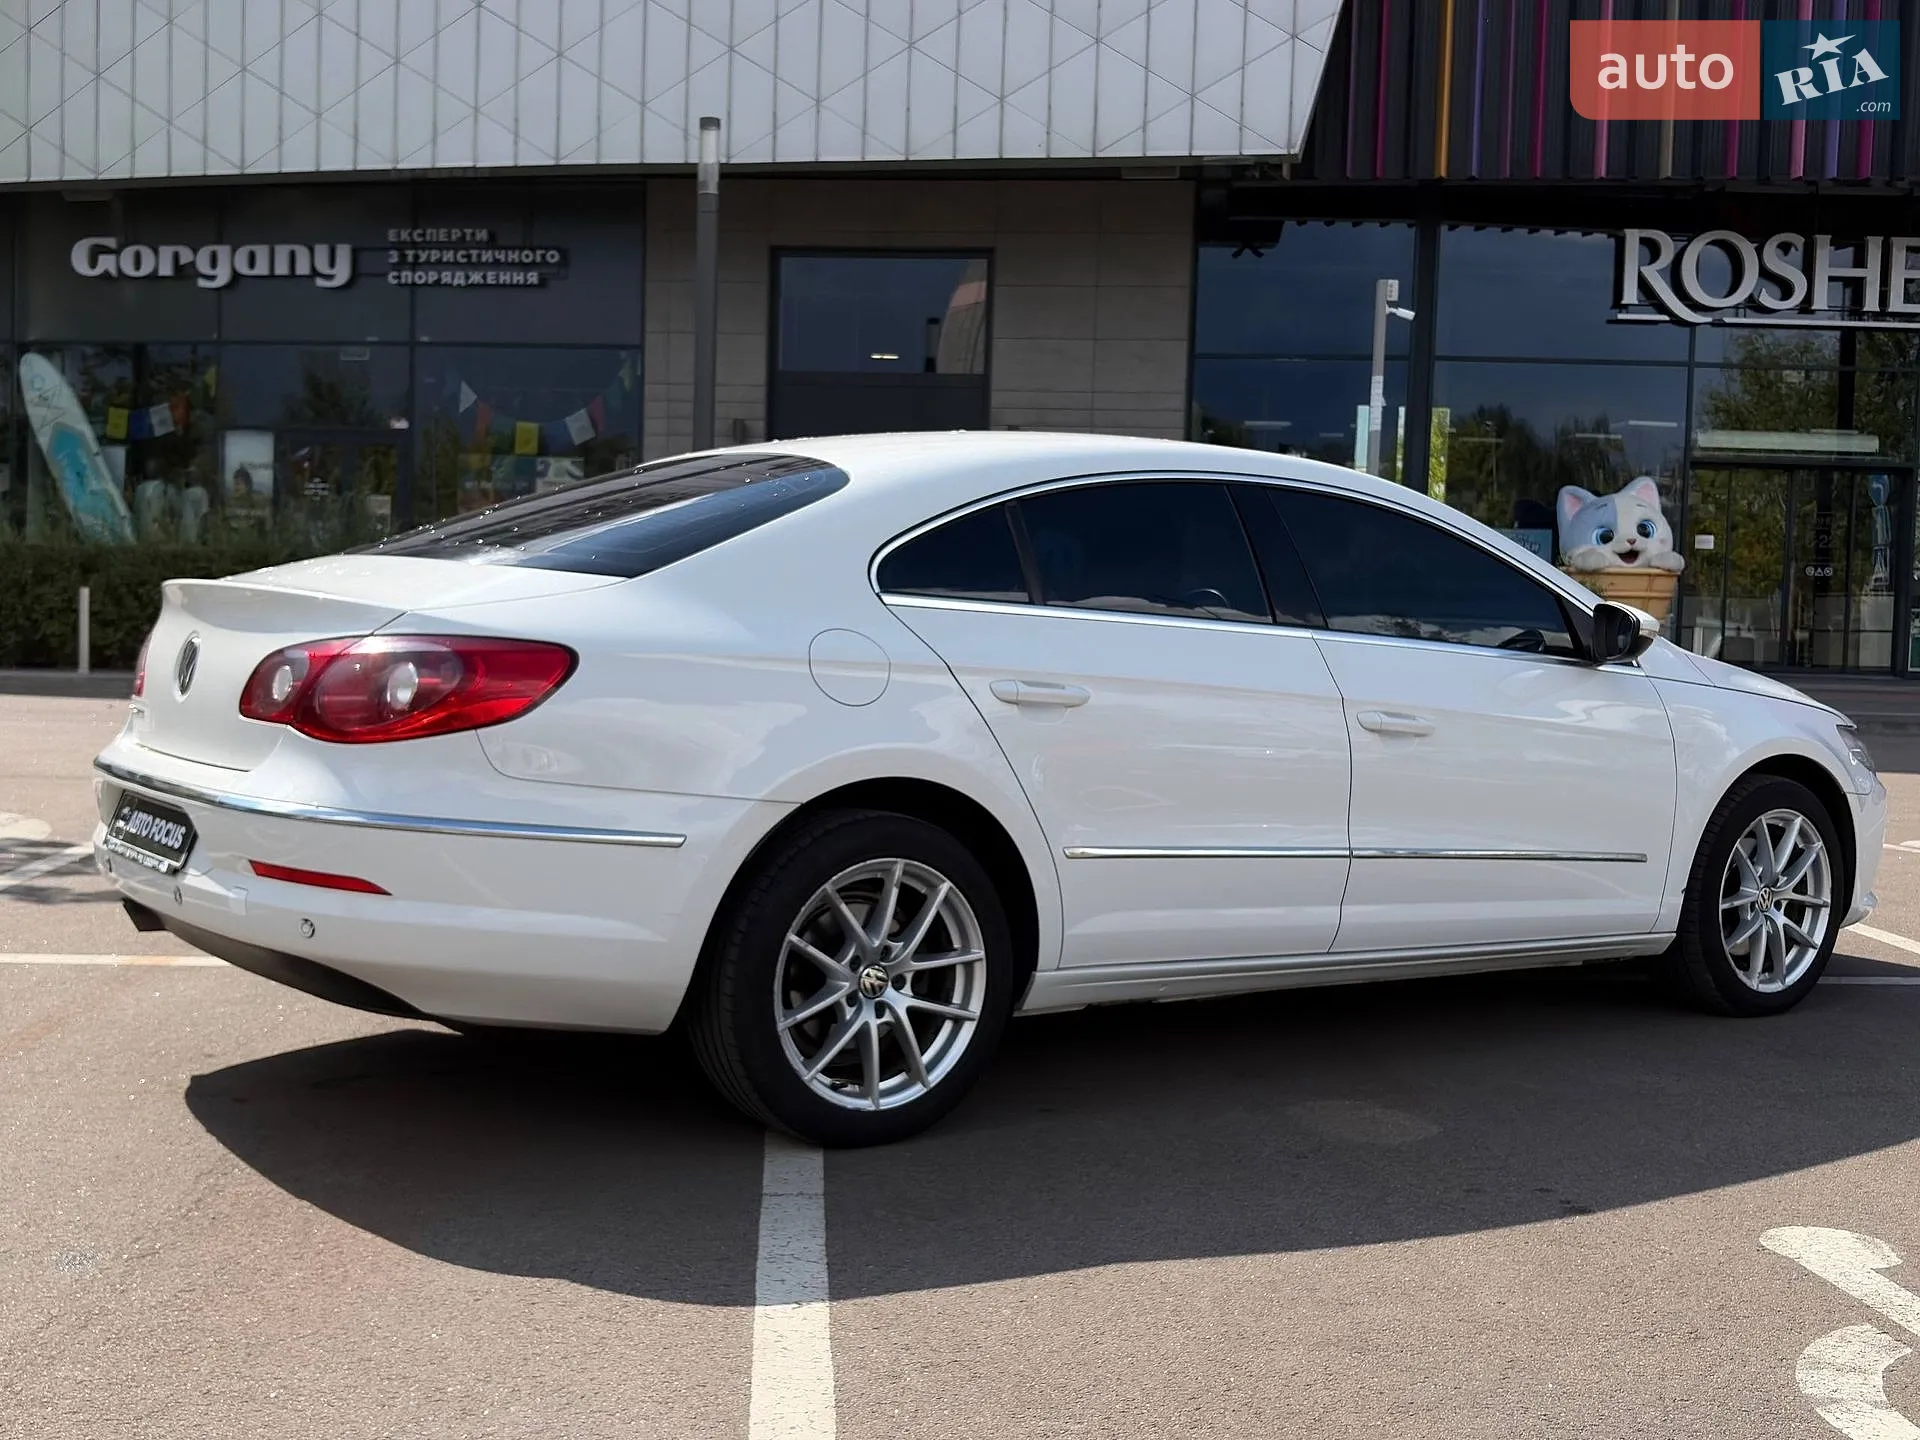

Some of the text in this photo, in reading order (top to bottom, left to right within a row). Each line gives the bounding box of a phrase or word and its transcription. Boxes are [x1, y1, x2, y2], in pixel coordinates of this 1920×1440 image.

[387, 228, 489, 243] ЕКСПЕРТИ
[70, 236, 353, 289] Gorgany
[405, 249, 561, 264] ТУРИСТИЧНОГО
[387, 271, 540, 287] СПОРЯДЖЕННЯ
